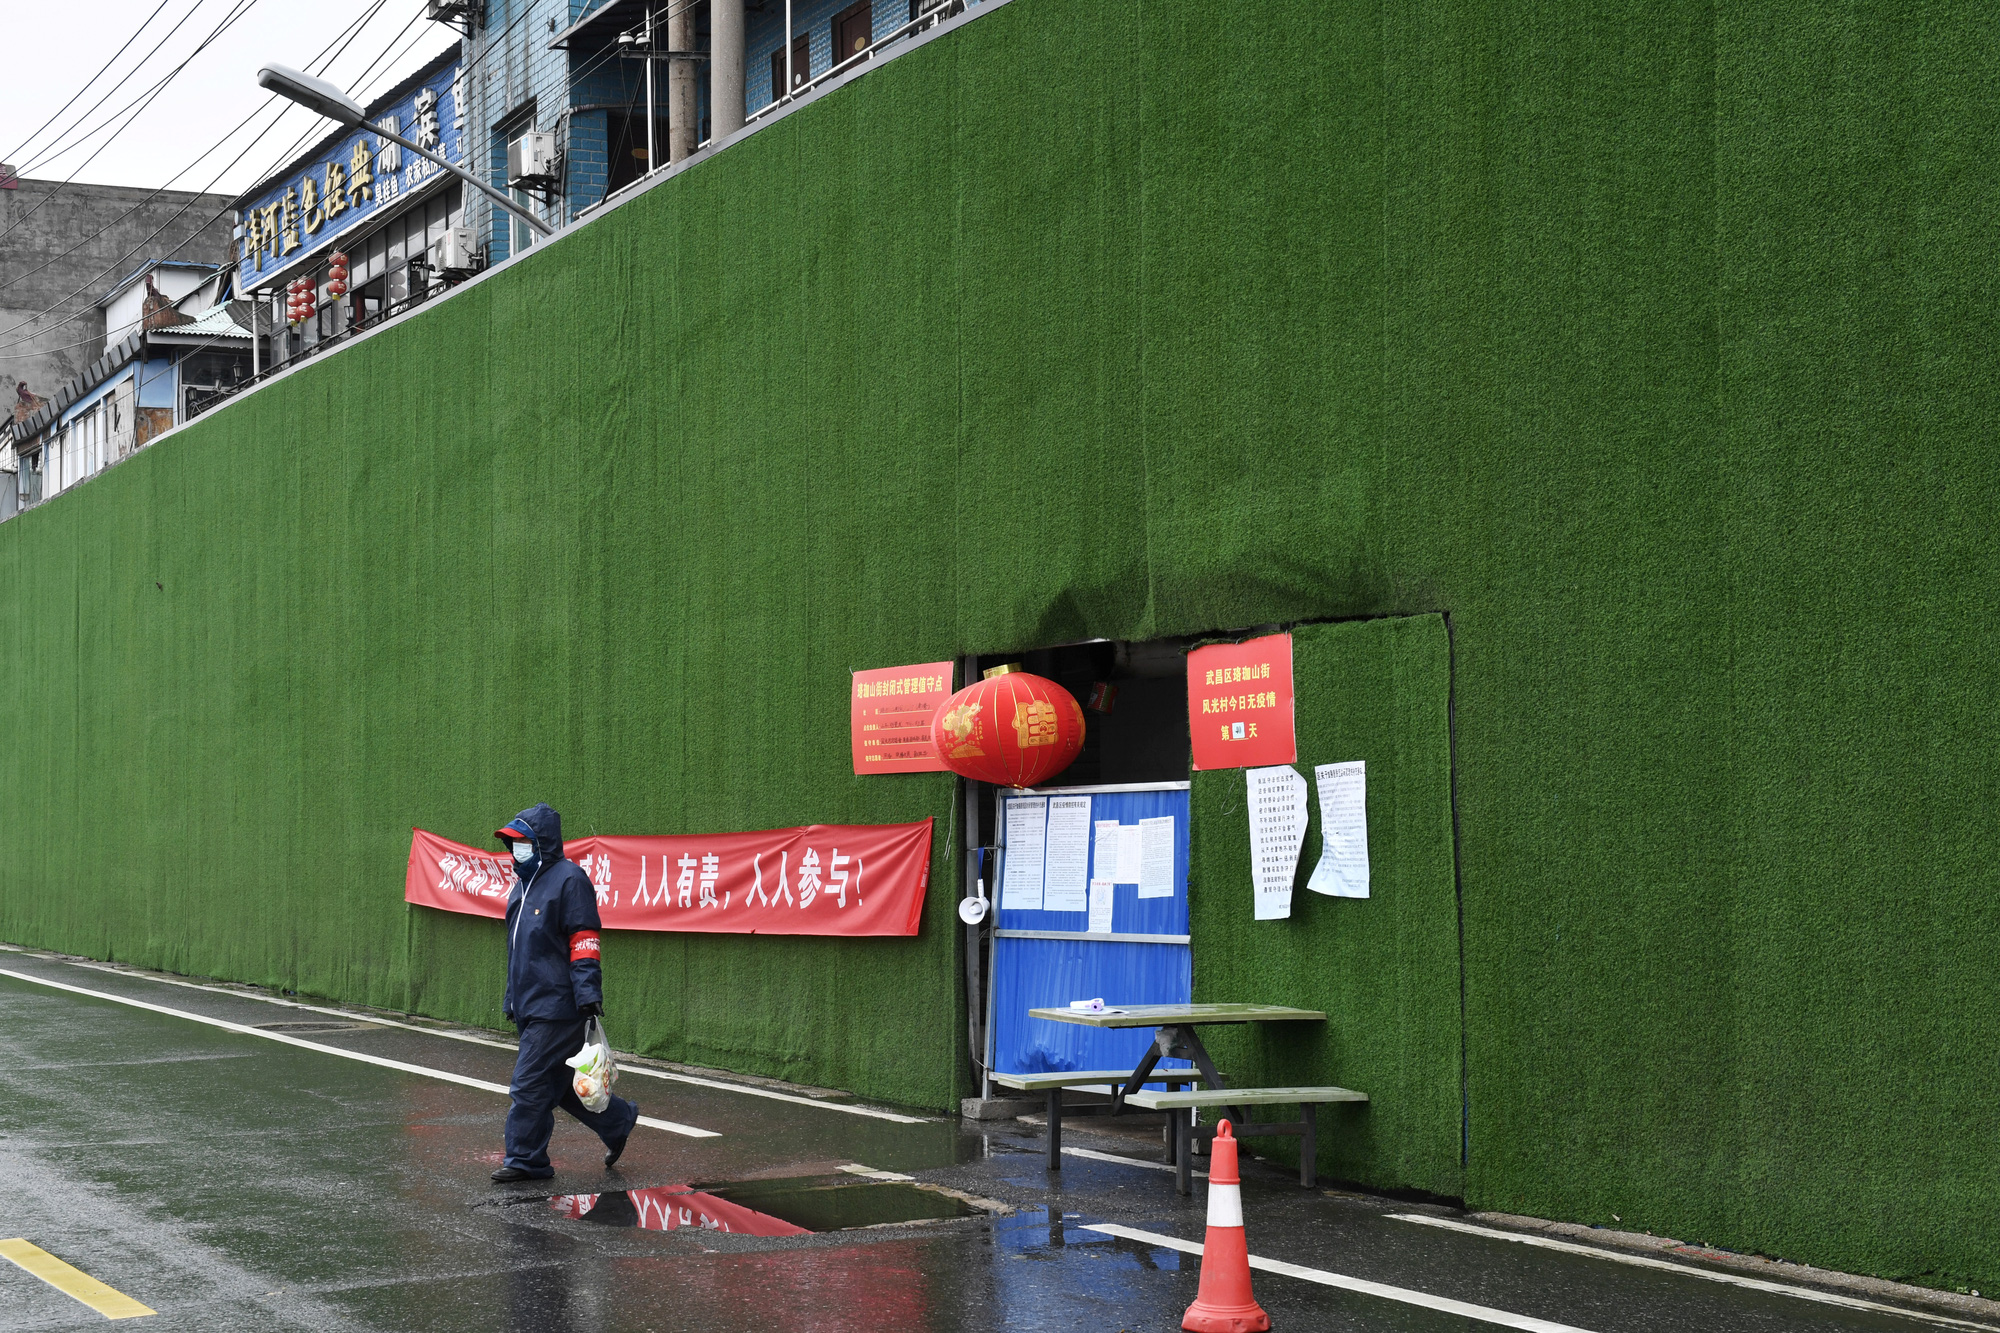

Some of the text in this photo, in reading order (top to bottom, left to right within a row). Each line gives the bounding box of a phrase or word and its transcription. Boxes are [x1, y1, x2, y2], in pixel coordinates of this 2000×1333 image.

[1205, 662, 1271, 686] 武昌区珞珈山街
[857, 674, 943, 699] 珞珈山街封闭式管理值守点
[1202, 691, 1276, 715] 风光村今日无疫情
